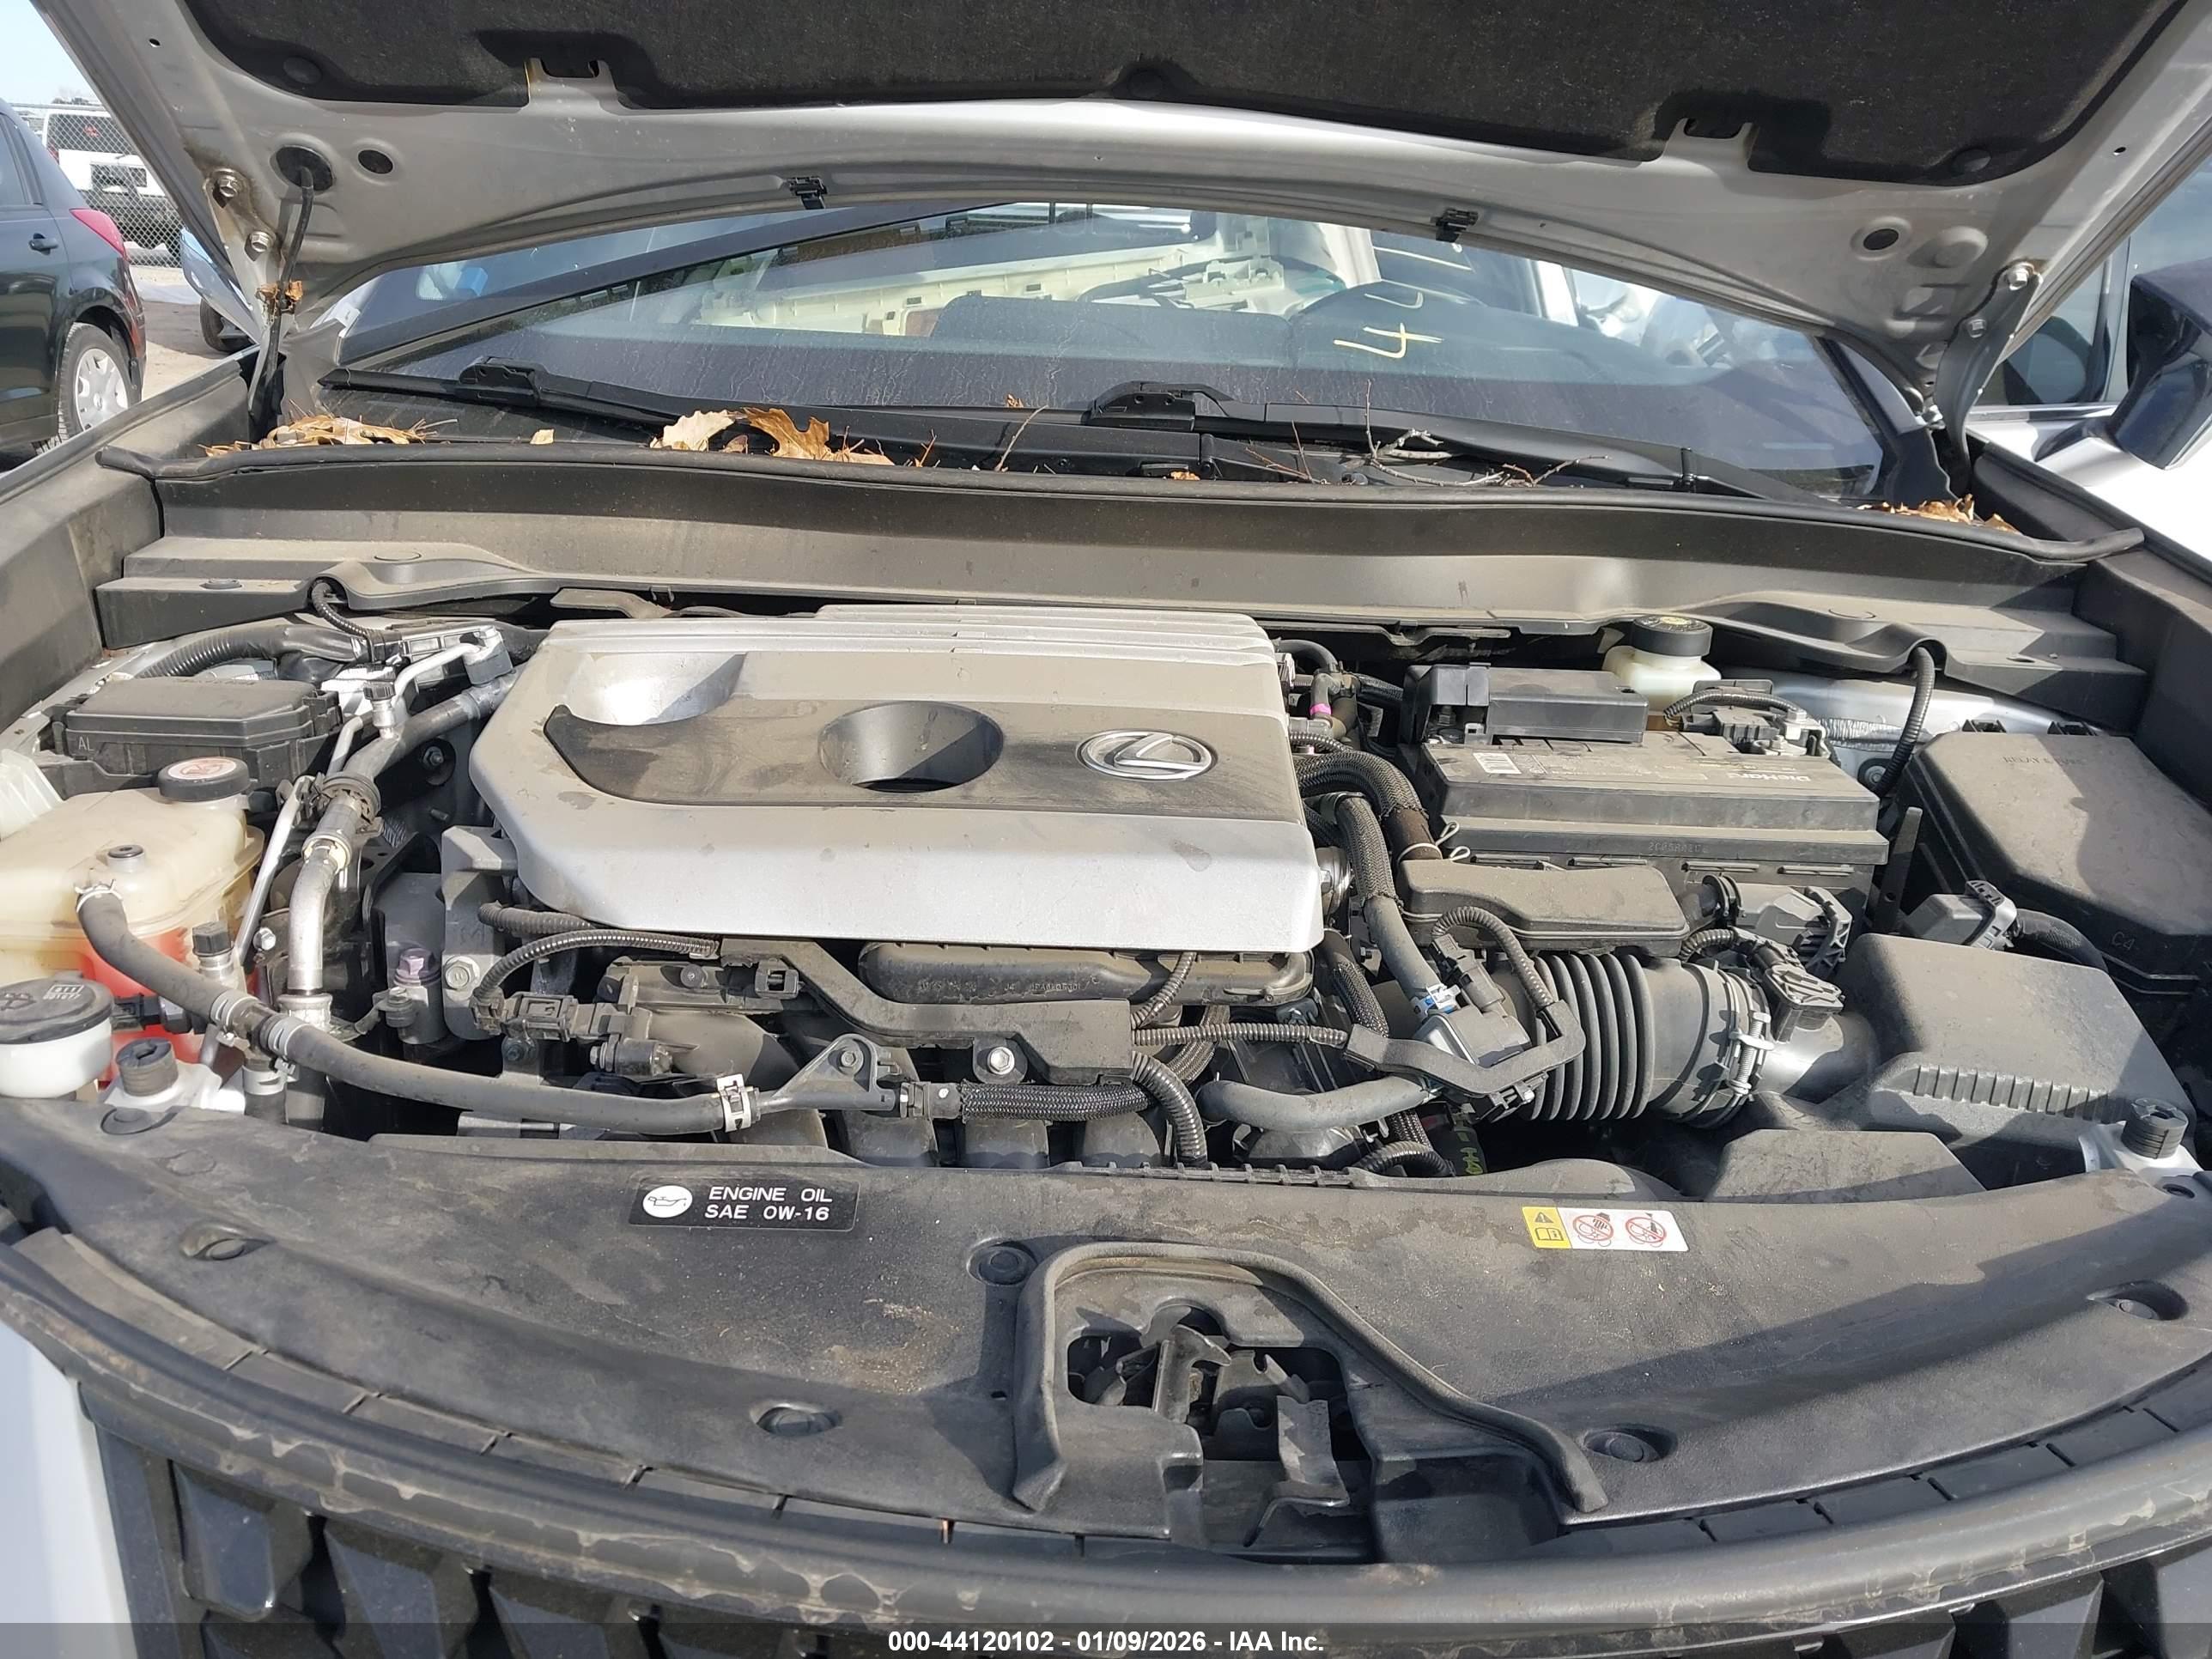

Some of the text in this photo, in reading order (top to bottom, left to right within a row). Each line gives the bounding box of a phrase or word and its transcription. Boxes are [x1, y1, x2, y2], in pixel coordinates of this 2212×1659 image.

[708, 1186, 833, 1202] ENGINE OIL
[704, 1204, 830, 1221] SAE 0W-16
